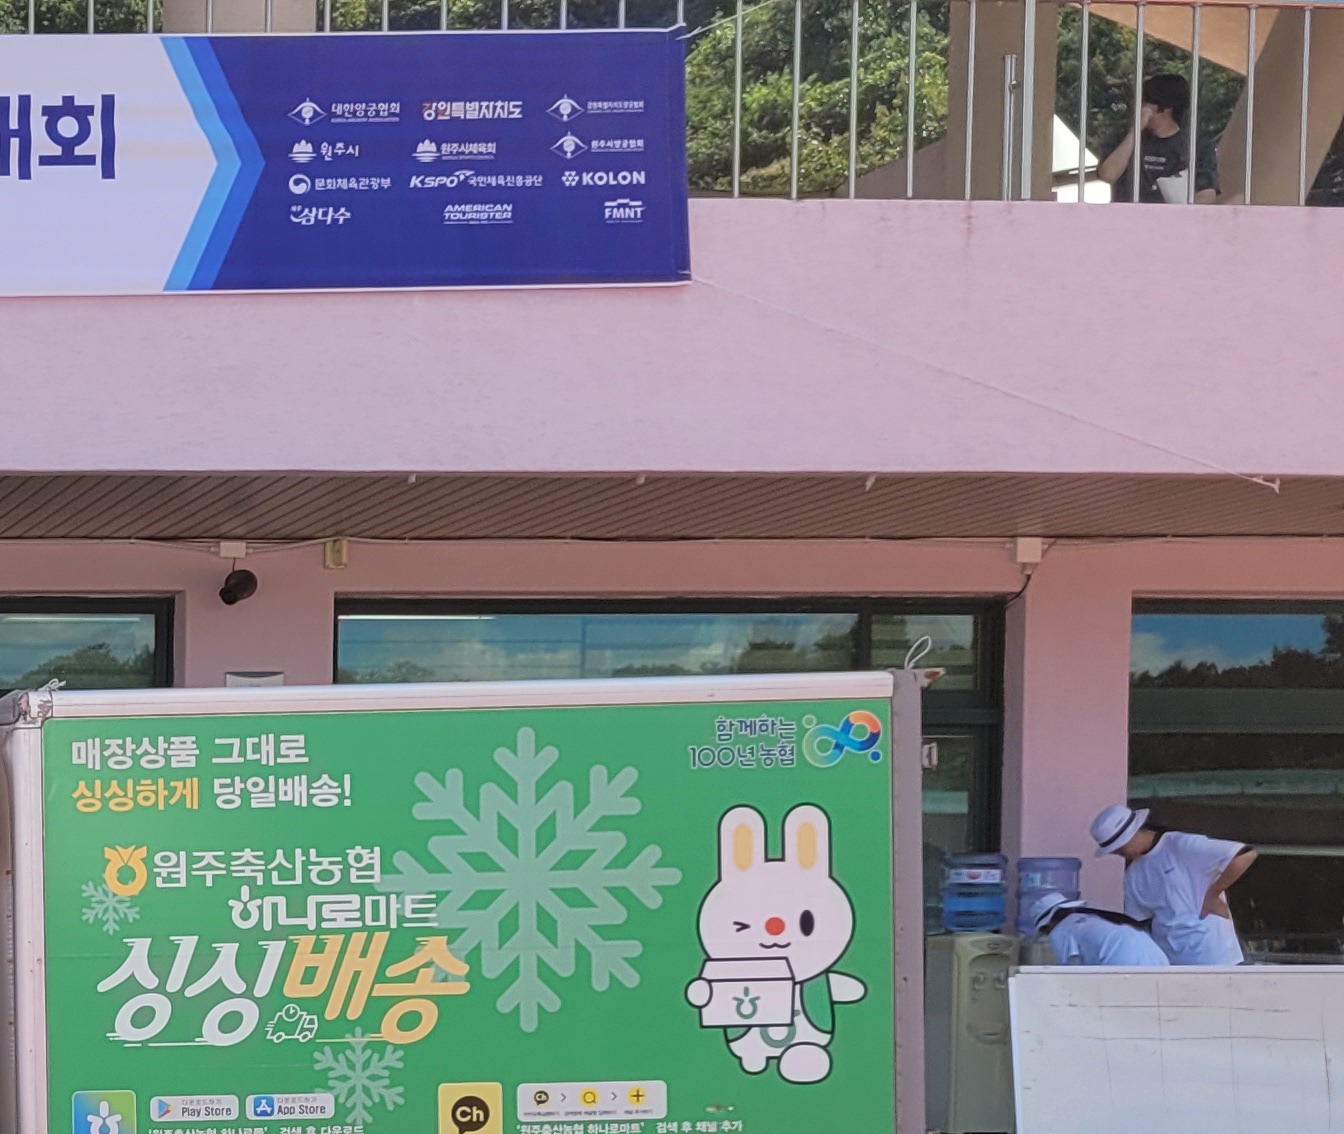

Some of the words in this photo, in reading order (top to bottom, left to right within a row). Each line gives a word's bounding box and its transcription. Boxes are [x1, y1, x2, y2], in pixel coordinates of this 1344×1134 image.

[331, 101, 401, 118] 대한양궁협회
[422, 100, 524, 121] 강원특별자치도
[319, 141, 360, 162] 원주시
[314, 176, 392, 191] 문화체육관광부
[409, 175, 459, 189] KSPO
[467, 174, 543, 188] 국민체육진흥공단
[581, 170, 646, 185] KOLON
[290, 206, 352, 226] 삼다수
[443, 211, 513, 220] TOURISTER
[444, 204, 513, 213] AMERICAN
[604, 206, 646, 220] FMNT
[716, 716, 797, 742] 함께하는
[71, 736, 200, 771] 매장상품
[211, 733, 310, 767] 그대로
[689, 747, 756, 768] 100년
[758, 744, 797, 768] 농협
[71, 777, 200, 814] 싱싱하게
[212, 773, 352, 810] 당일배송!
[152, 845, 382, 889] 원주축산농협
[228, 884, 439, 931] 하나로마트
[97, 930, 471, 1047] 싱싱배송
[182, 1106, 202, 1118] Play
[204, 1105, 232, 1117] Store
[277, 1105, 296, 1116] App
[298, 1104, 327, 1115] Store
[456, 1102, 484, 1123] Ch
[656, 1121, 678, 1134] 검색
[680, 1120, 693, 1133] 후
[719, 1120, 748, 1133] 추가
